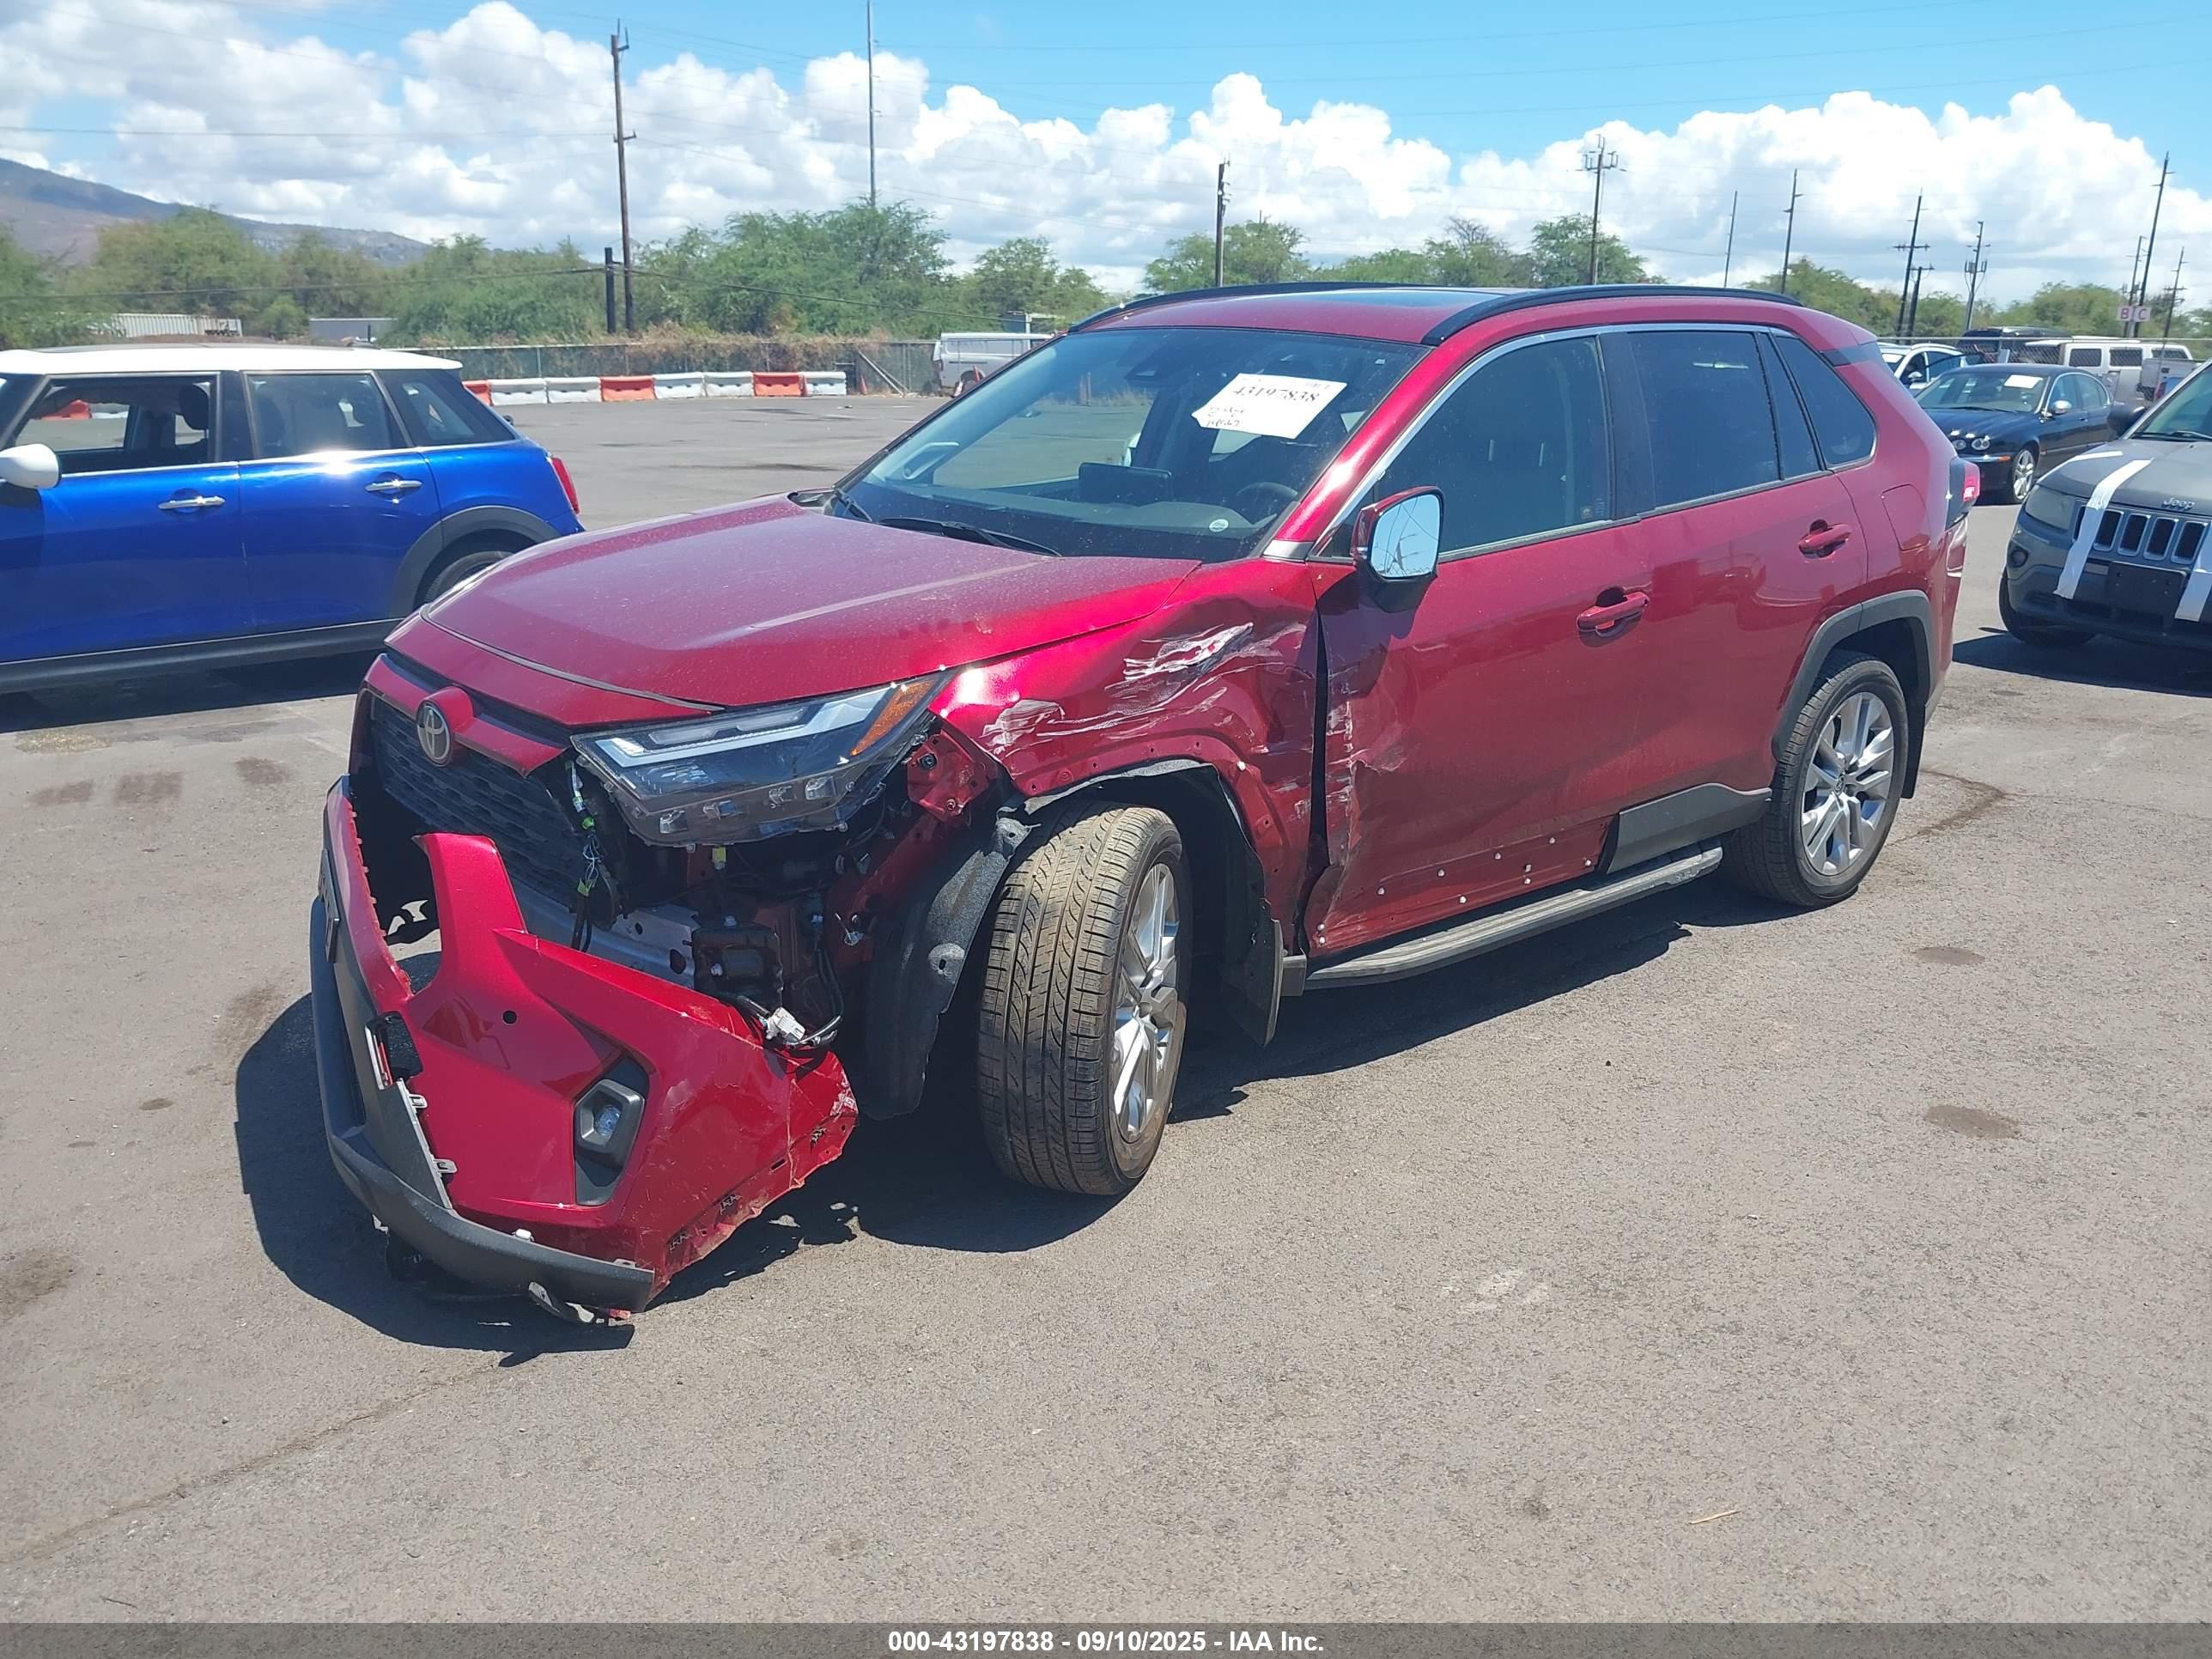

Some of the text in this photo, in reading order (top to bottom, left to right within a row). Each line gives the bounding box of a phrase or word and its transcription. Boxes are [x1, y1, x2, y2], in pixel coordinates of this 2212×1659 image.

[2120, 307, 2130, 319] B
[2138, 308, 2148, 320] C
[2163, 497, 2196, 509] Jeep
